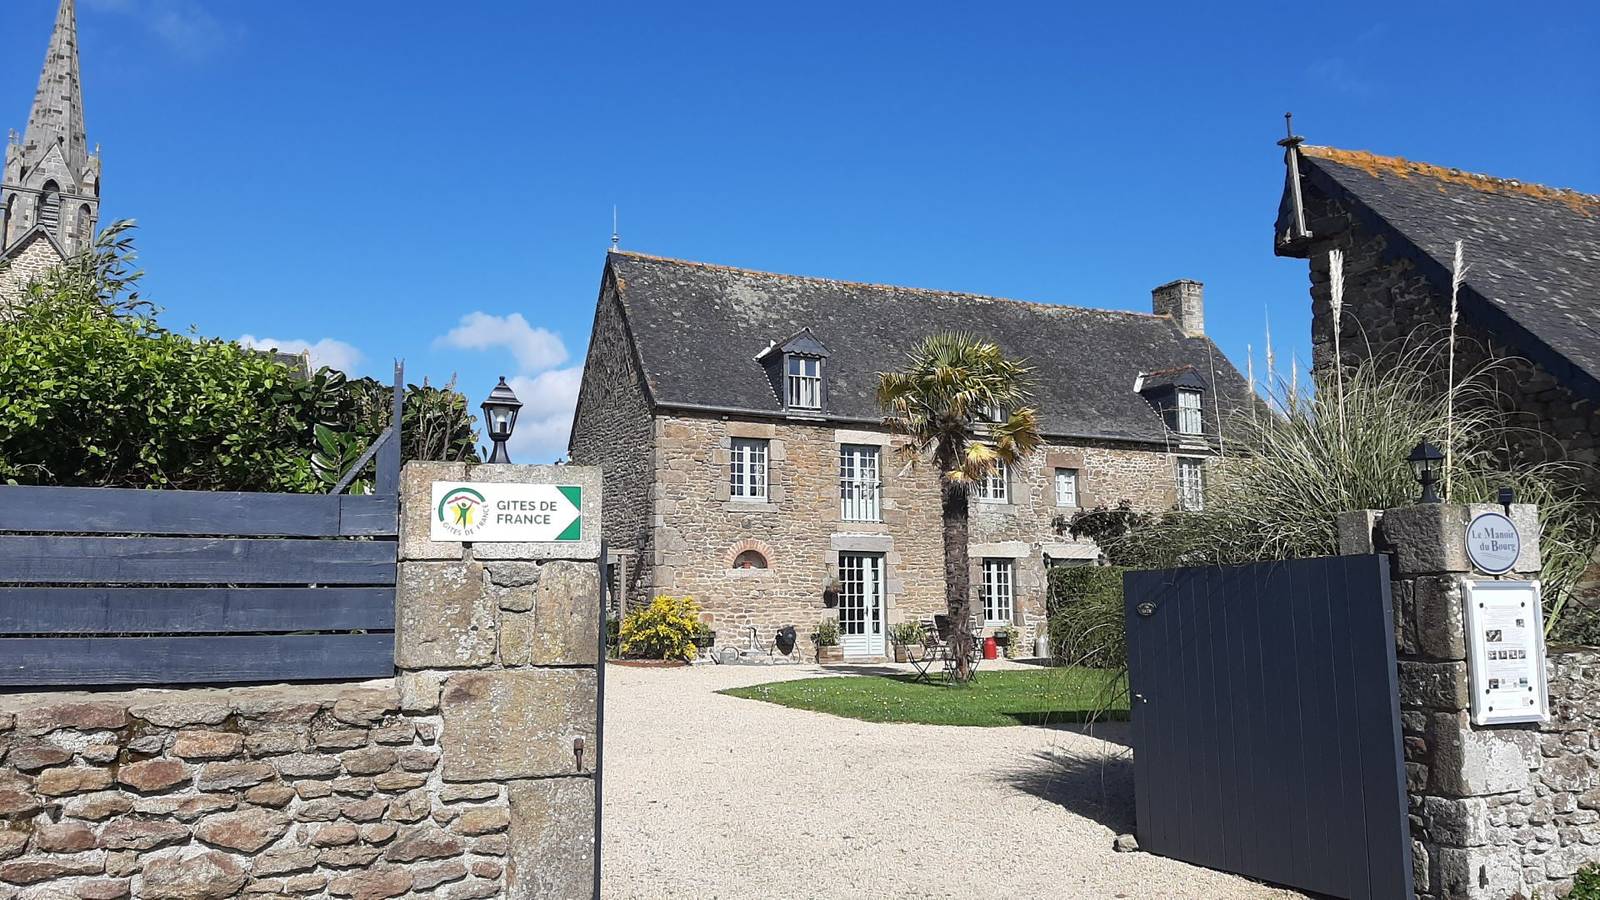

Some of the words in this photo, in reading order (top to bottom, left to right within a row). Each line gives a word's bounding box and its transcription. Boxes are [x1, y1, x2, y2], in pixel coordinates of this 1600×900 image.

[496, 500, 536, 511] GITES
[540, 501, 557, 511] DE
[496, 514, 551, 525] FRANCE
[1471, 530, 1482, 539] Le
[1484, 527, 1514, 539] Manoir
[1479, 542, 1490, 551] du
[1491, 540, 1516, 552] Bourg
